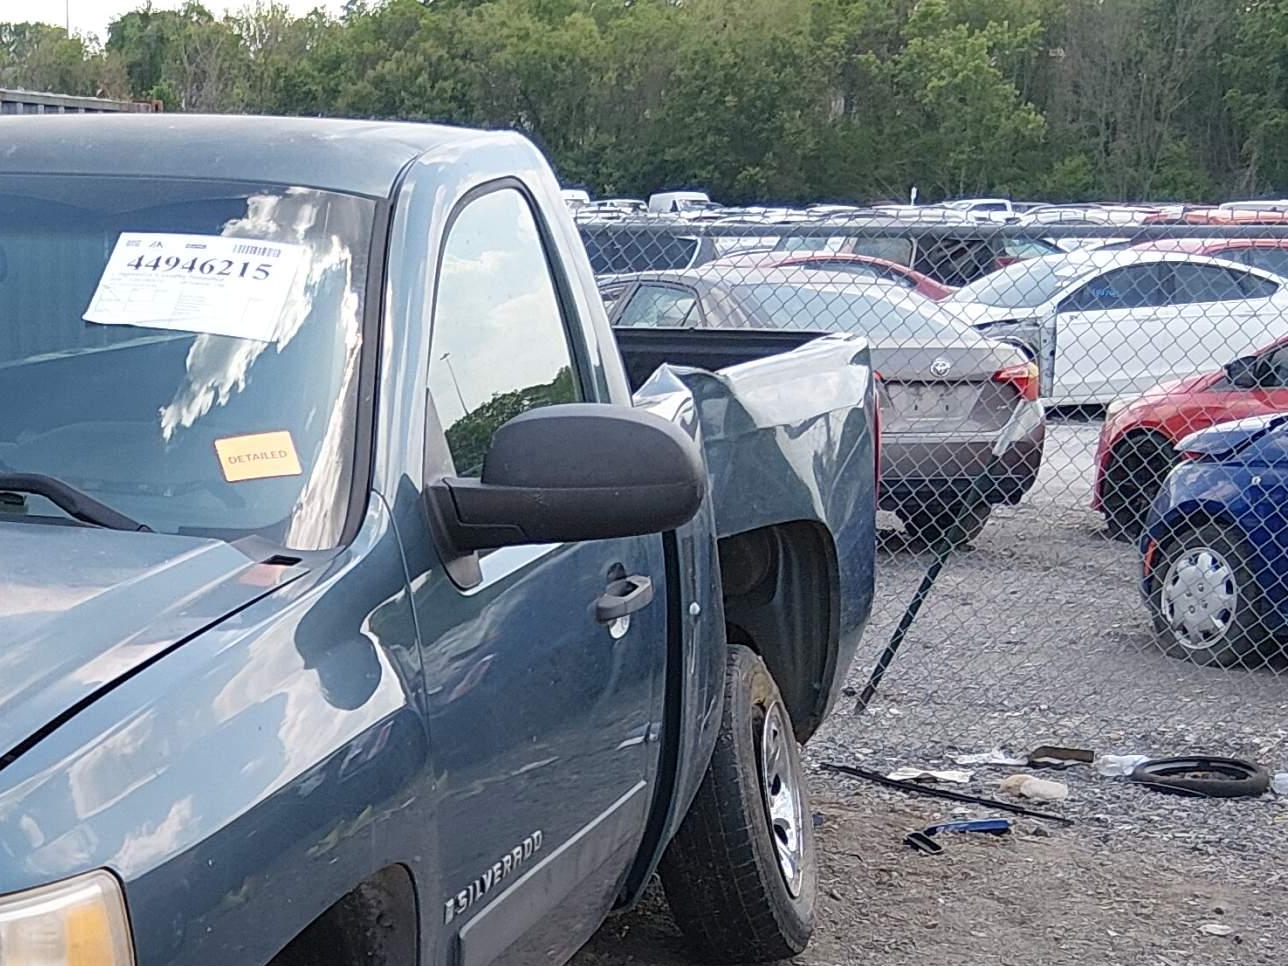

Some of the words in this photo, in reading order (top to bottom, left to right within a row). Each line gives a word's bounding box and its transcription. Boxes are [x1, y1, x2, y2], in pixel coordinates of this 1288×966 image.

[126, 254, 273, 281] 44946215
[227, 449, 288, 465] DETAILED
[454, 829, 544, 915] SILVERADO
